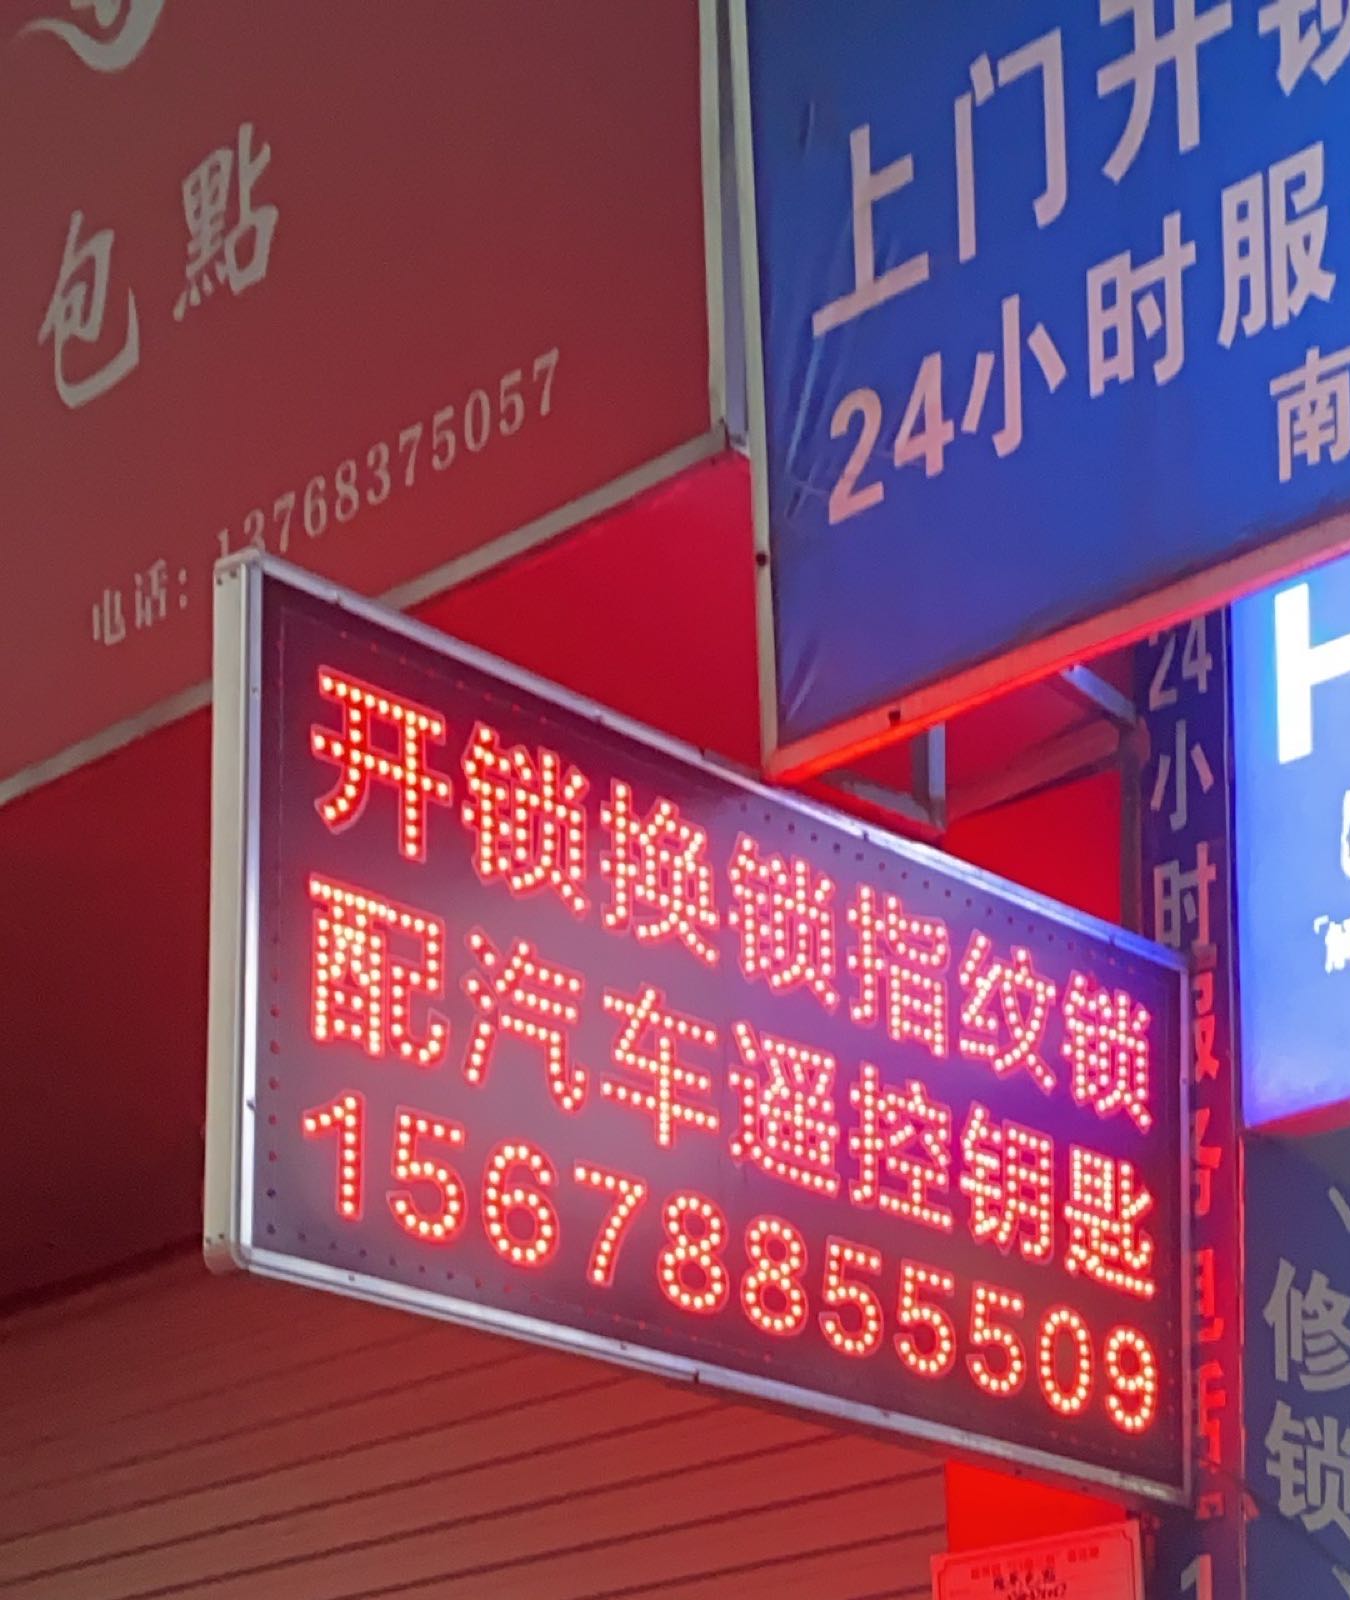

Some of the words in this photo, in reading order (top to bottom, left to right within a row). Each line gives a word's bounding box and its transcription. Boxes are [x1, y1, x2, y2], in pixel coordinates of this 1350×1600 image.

[214, 347, 560, 562] 13768375057
[306, 871, 1159, 1299] 配汽车遥控钥匙
[309, 663, 1156, 1136] 开锁换锁指纹锁
[300, 1088, 1160, 1436] 15678855509
